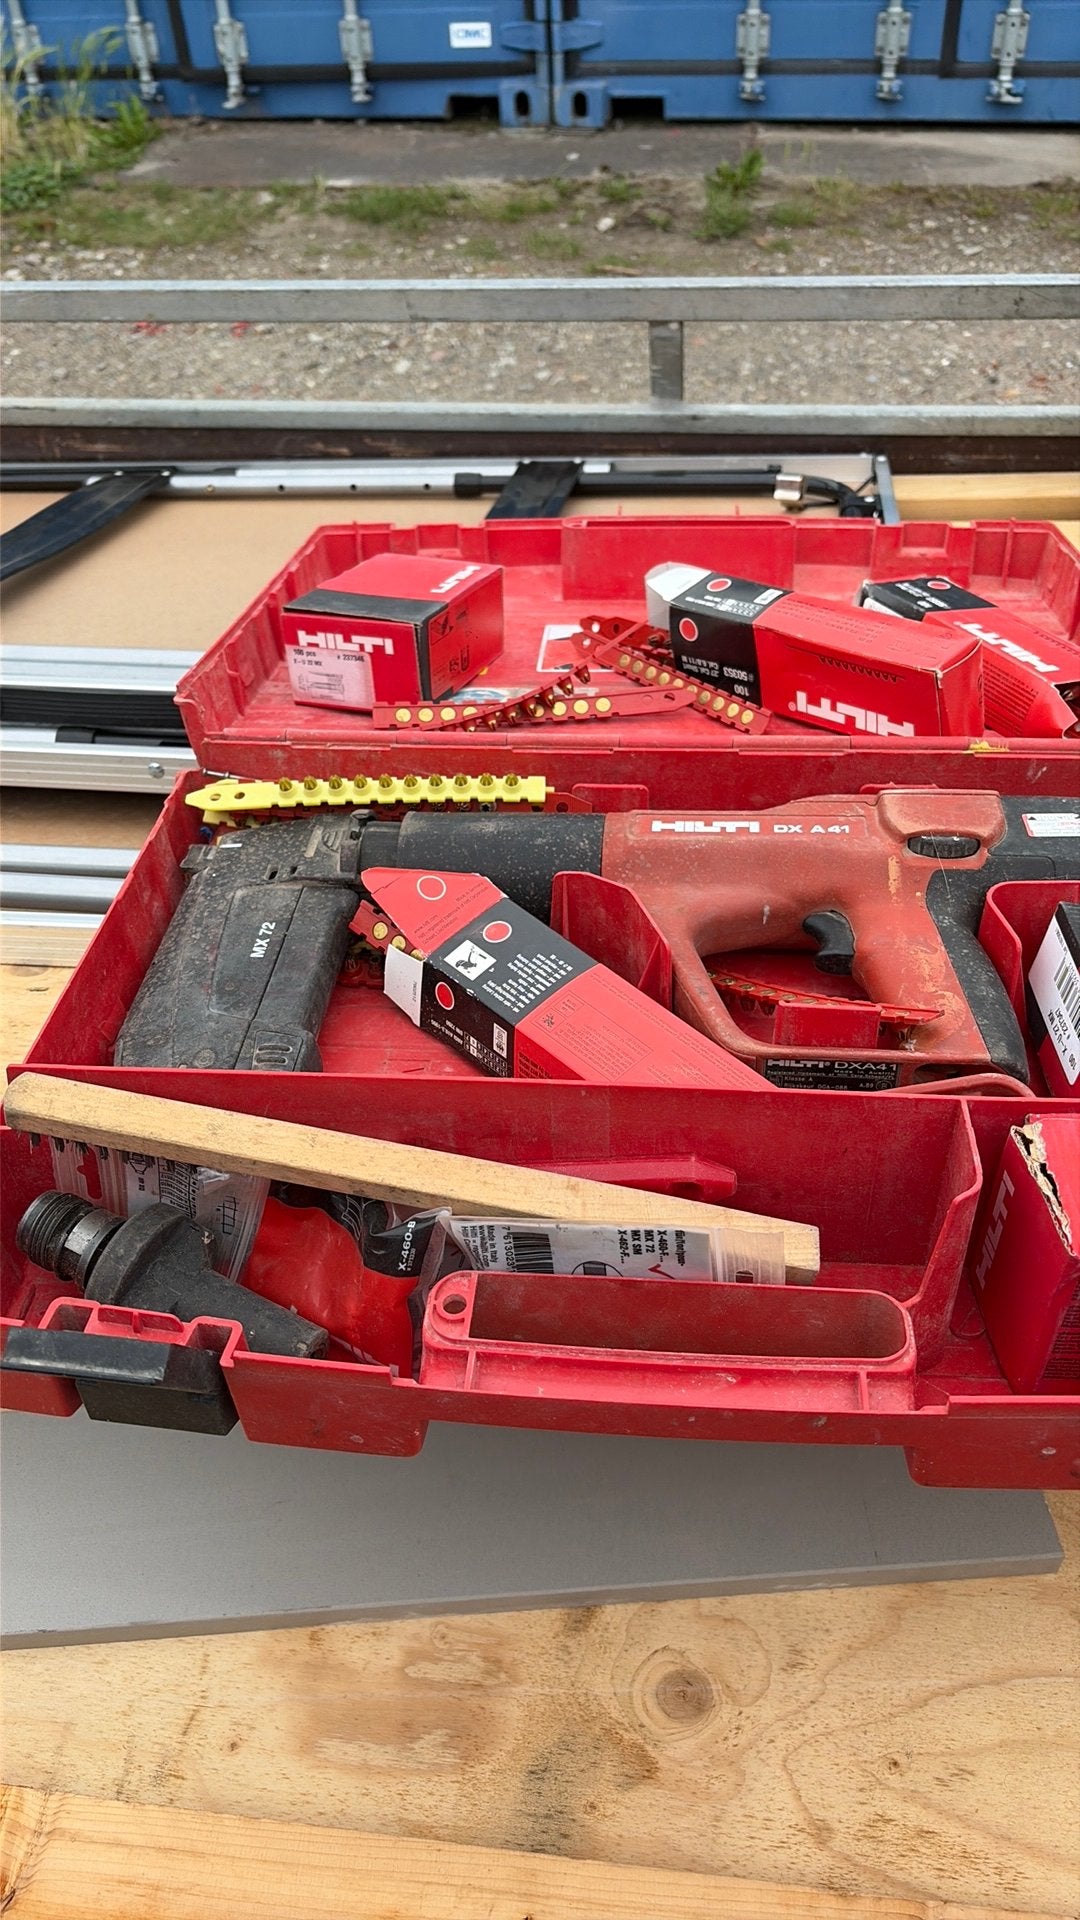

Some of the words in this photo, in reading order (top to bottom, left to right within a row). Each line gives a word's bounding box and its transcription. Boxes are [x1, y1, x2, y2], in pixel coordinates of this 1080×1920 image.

[430, 565, 481, 593] HILTI
[297, 630, 394, 655] HILTI
[961, 623, 1060, 673] HILTI
[733, 684, 749, 696] 100
[796, 691, 914, 737] HILTI
[652, 821, 760, 833] HILTI
[774, 825, 803, 833] DX
[811, 825, 850, 833] A41
[259, 922, 276, 935] 72
[250, 938, 270, 957] MX
[767, 1060, 824, 1068] HILTI
[487, 1225, 495, 1241] Made
[631, 1230, 641, 1242] MX
[644, 1230, 655, 1242] MX
[976, 1169, 1015, 1291] HILTI
[398, 1221, 416, 1272] X-460-B
[489, 1243, 495, 1251] in
[632, 1244, 643, 1255] SM
[645, 1244, 655, 1253] 72
[490, 1251, 498, 1263] Italy
